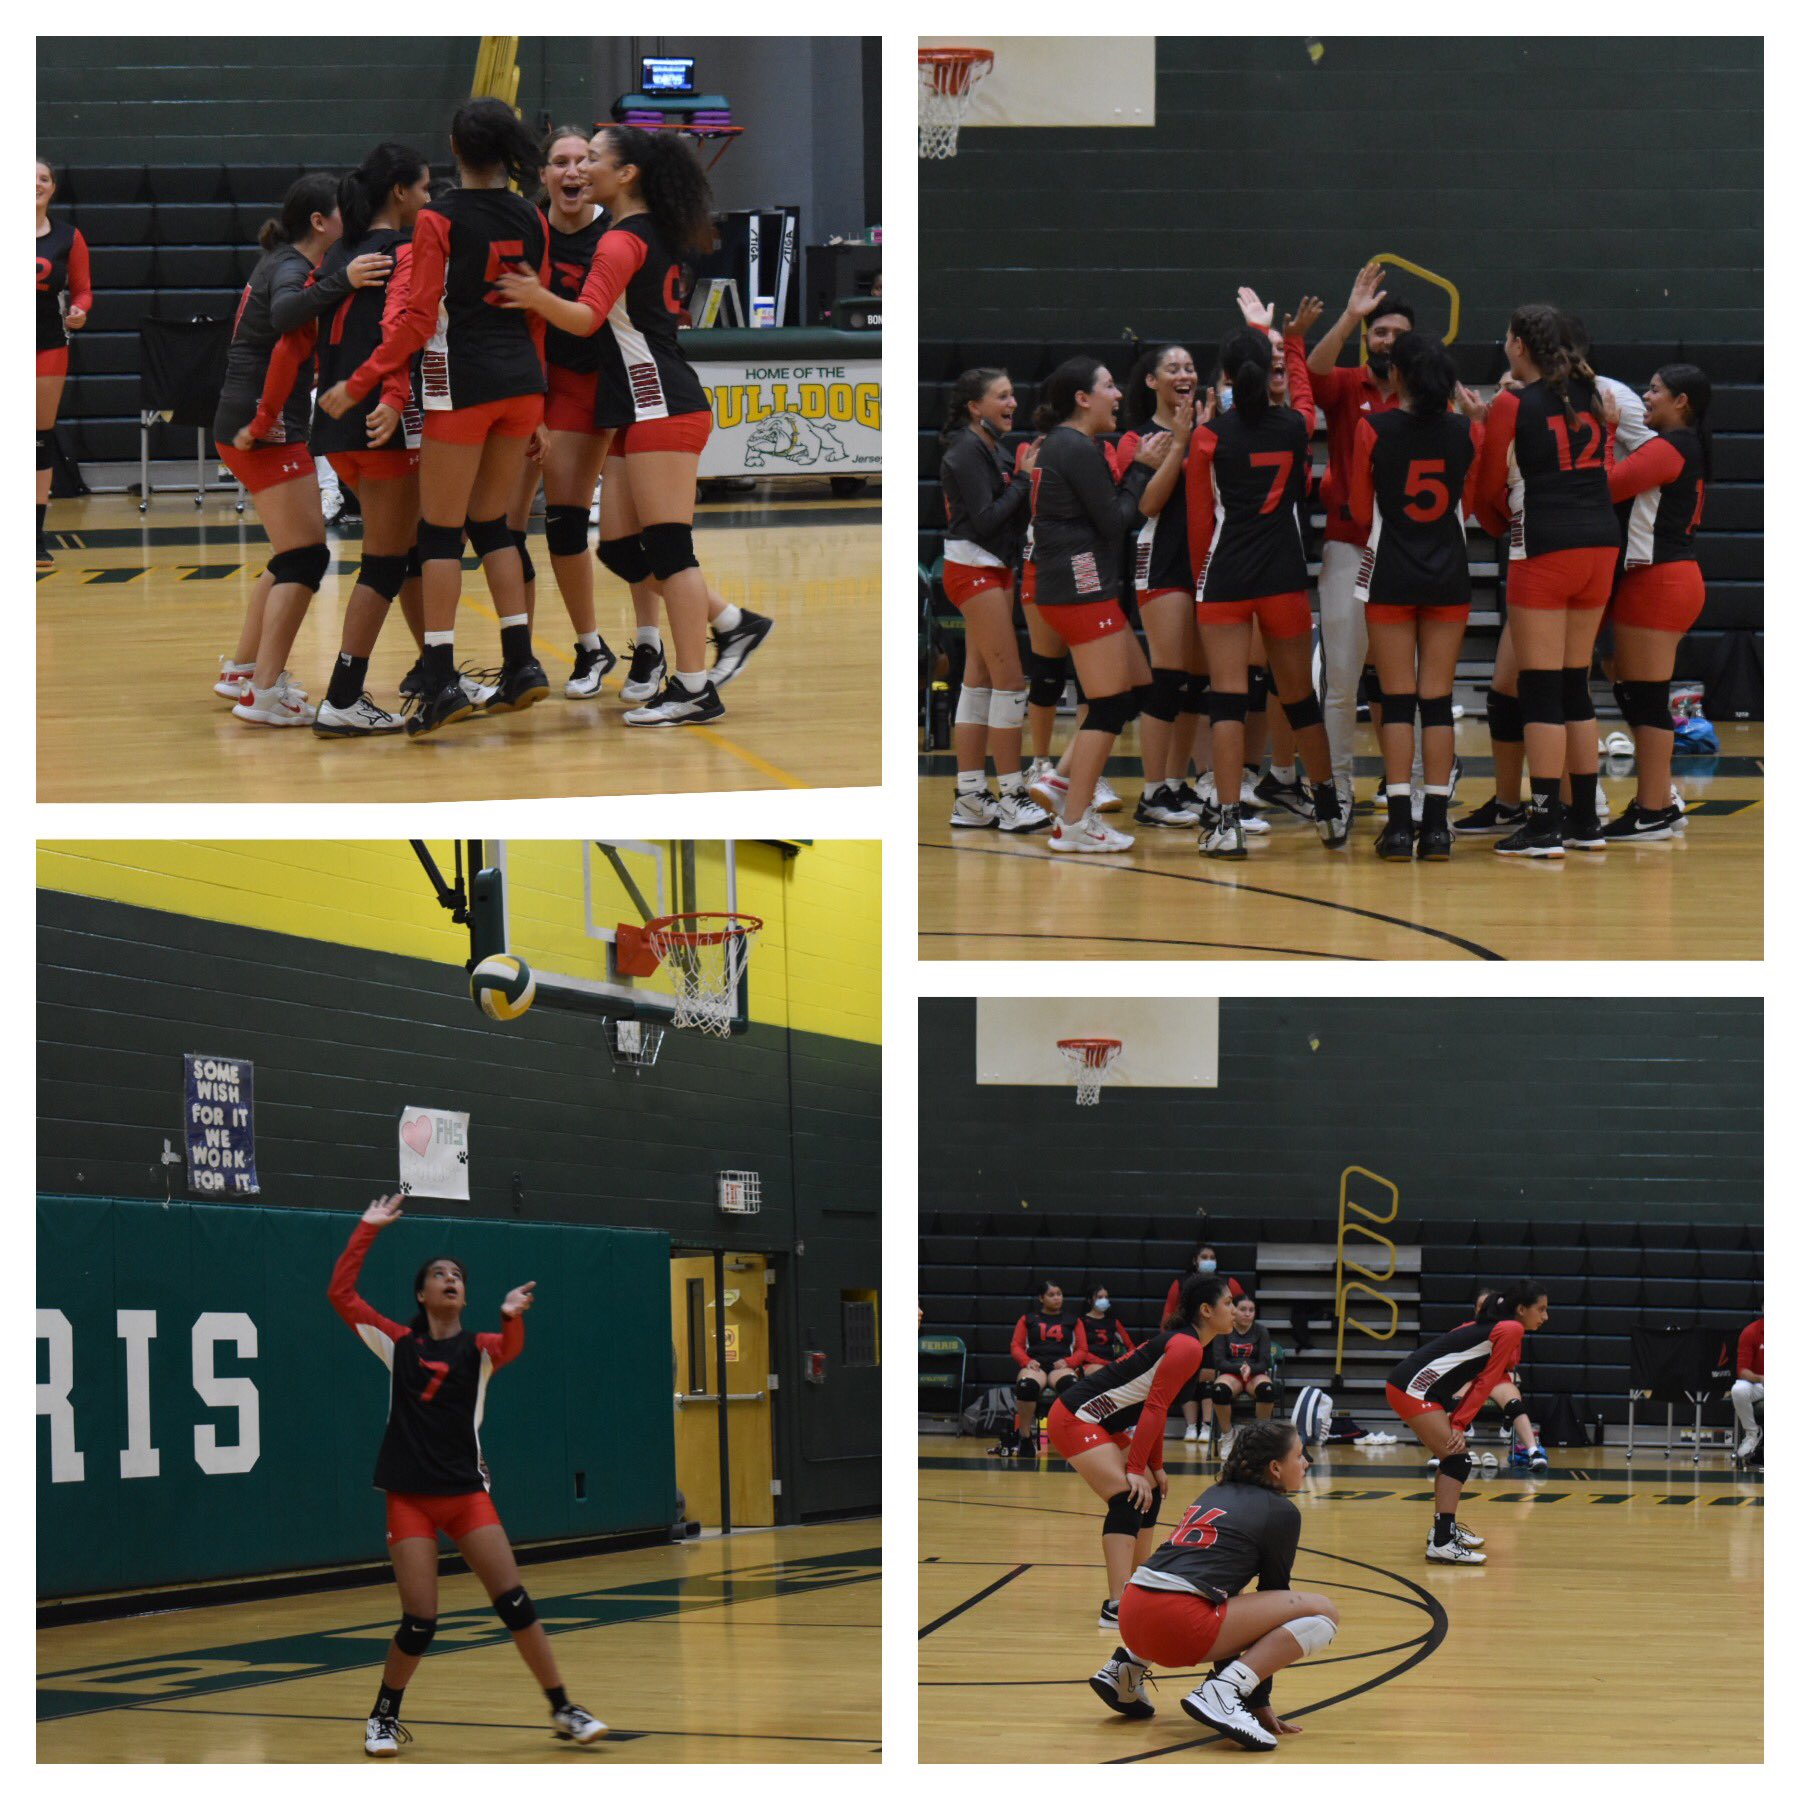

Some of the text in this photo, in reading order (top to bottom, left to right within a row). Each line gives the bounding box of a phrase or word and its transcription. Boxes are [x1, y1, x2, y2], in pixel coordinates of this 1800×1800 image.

[745, 366, 845, 380] HOME OF THE
[1546, 411, 1604, 471] 12
[1249, 451, 1293, 514] 7
[1403, 459, 1450, 523] 5
[193, 1060, 240, 1084] SOME
[196, 1080, 240, 1103] WISH
[192, 1103, 249, 1127] FOR IT
[205, 1128, 231, 1148] WE
[192, 1145, 246, 1168] WORK
[194, 1170, 250, 1192] FOR IT
[1038, 1322, 1064, 1342] 14
[1095, 1328, 1108, 1344] 3
[1230, 1342, 1253, 1359] 17
[419, 1357, 449, 1402] 7
[1169, 1505, 1227, 1549] 16
